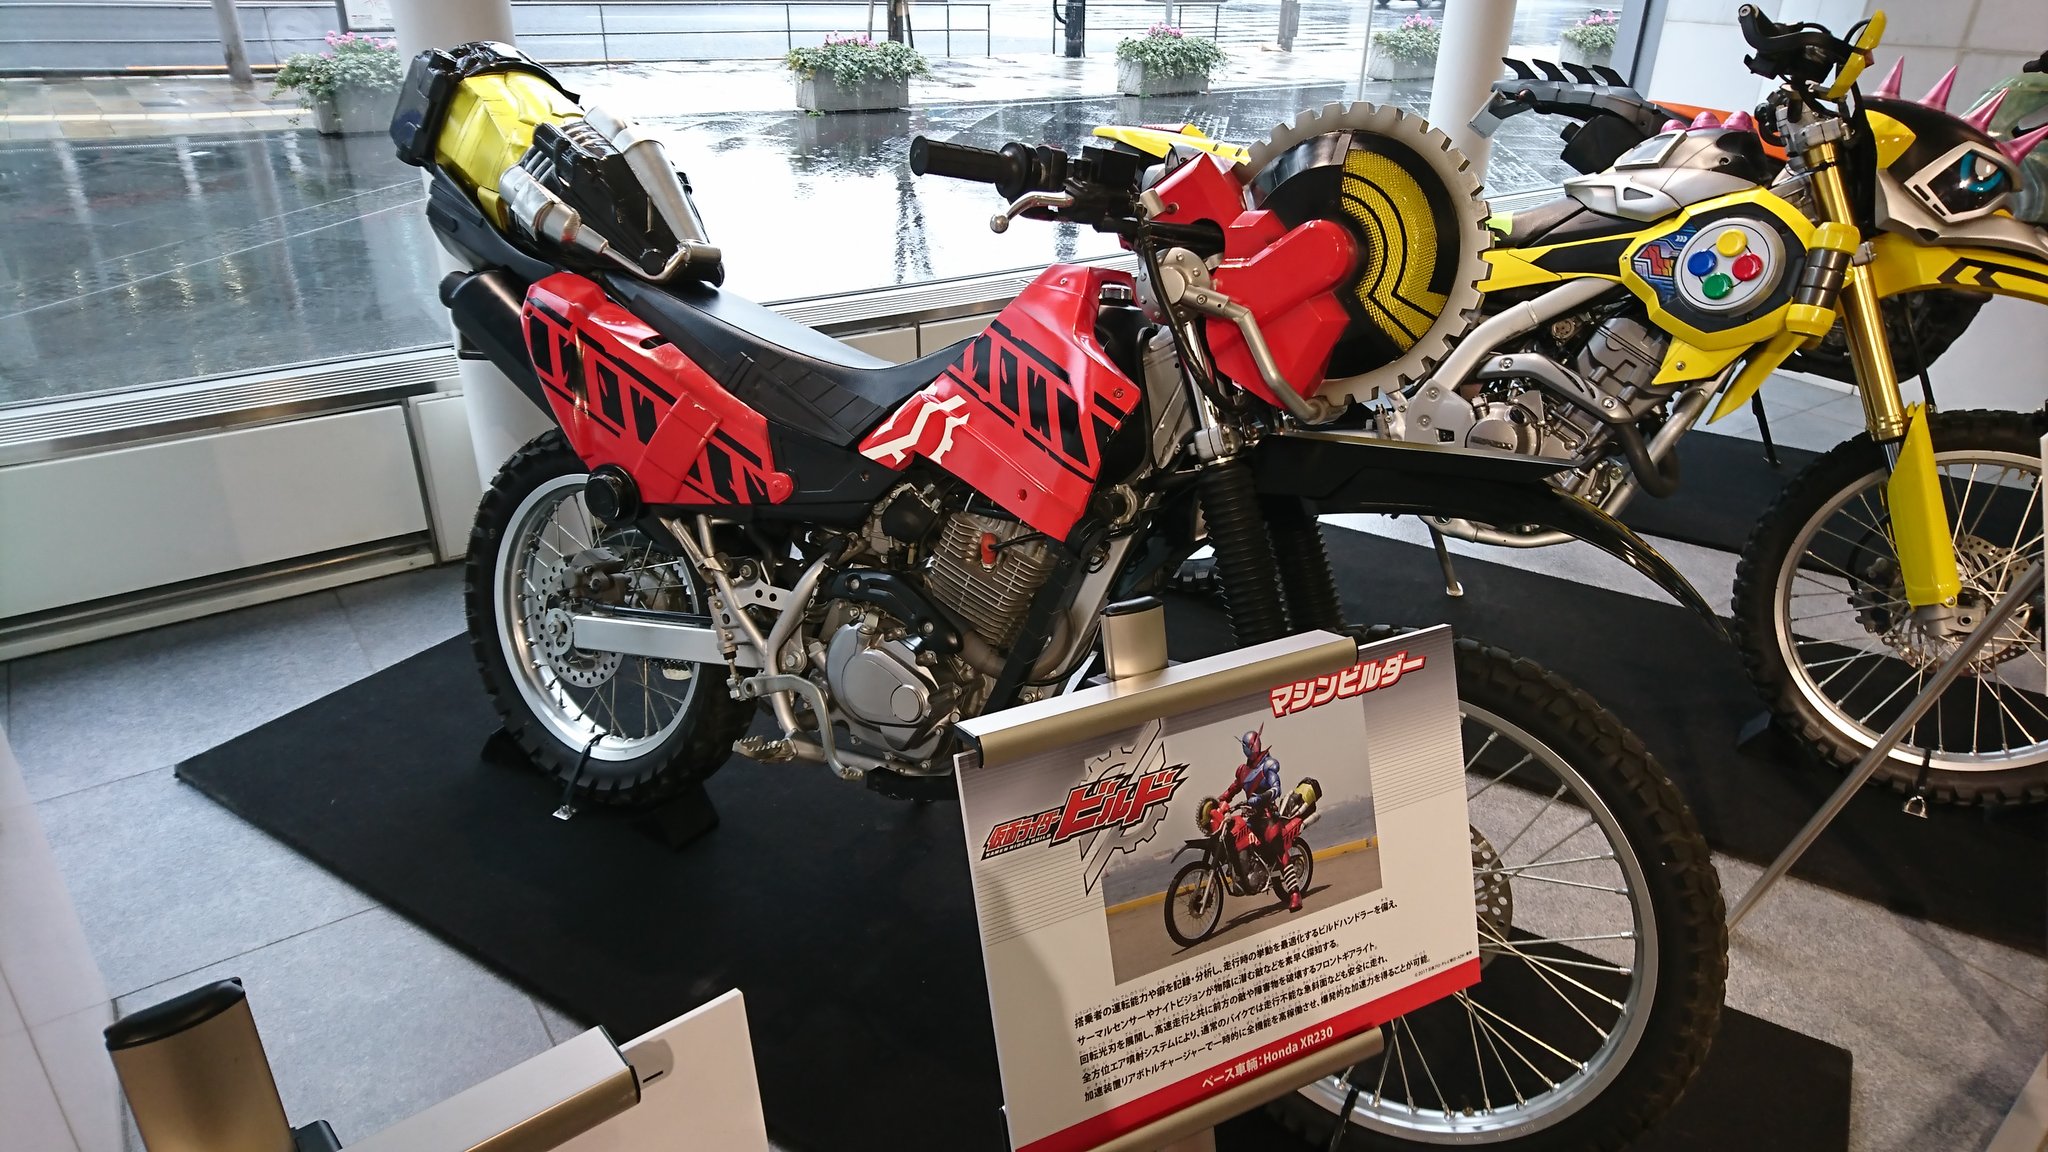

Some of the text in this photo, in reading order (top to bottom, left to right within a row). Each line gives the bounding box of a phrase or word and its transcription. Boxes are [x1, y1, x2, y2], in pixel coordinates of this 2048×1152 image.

[1270, 651, 1424, 716] マシンビルダー
[986, 767, 1178, 851] 仮面ライダー ビルド
[1300, 1026, 1334, 1050] XR230
